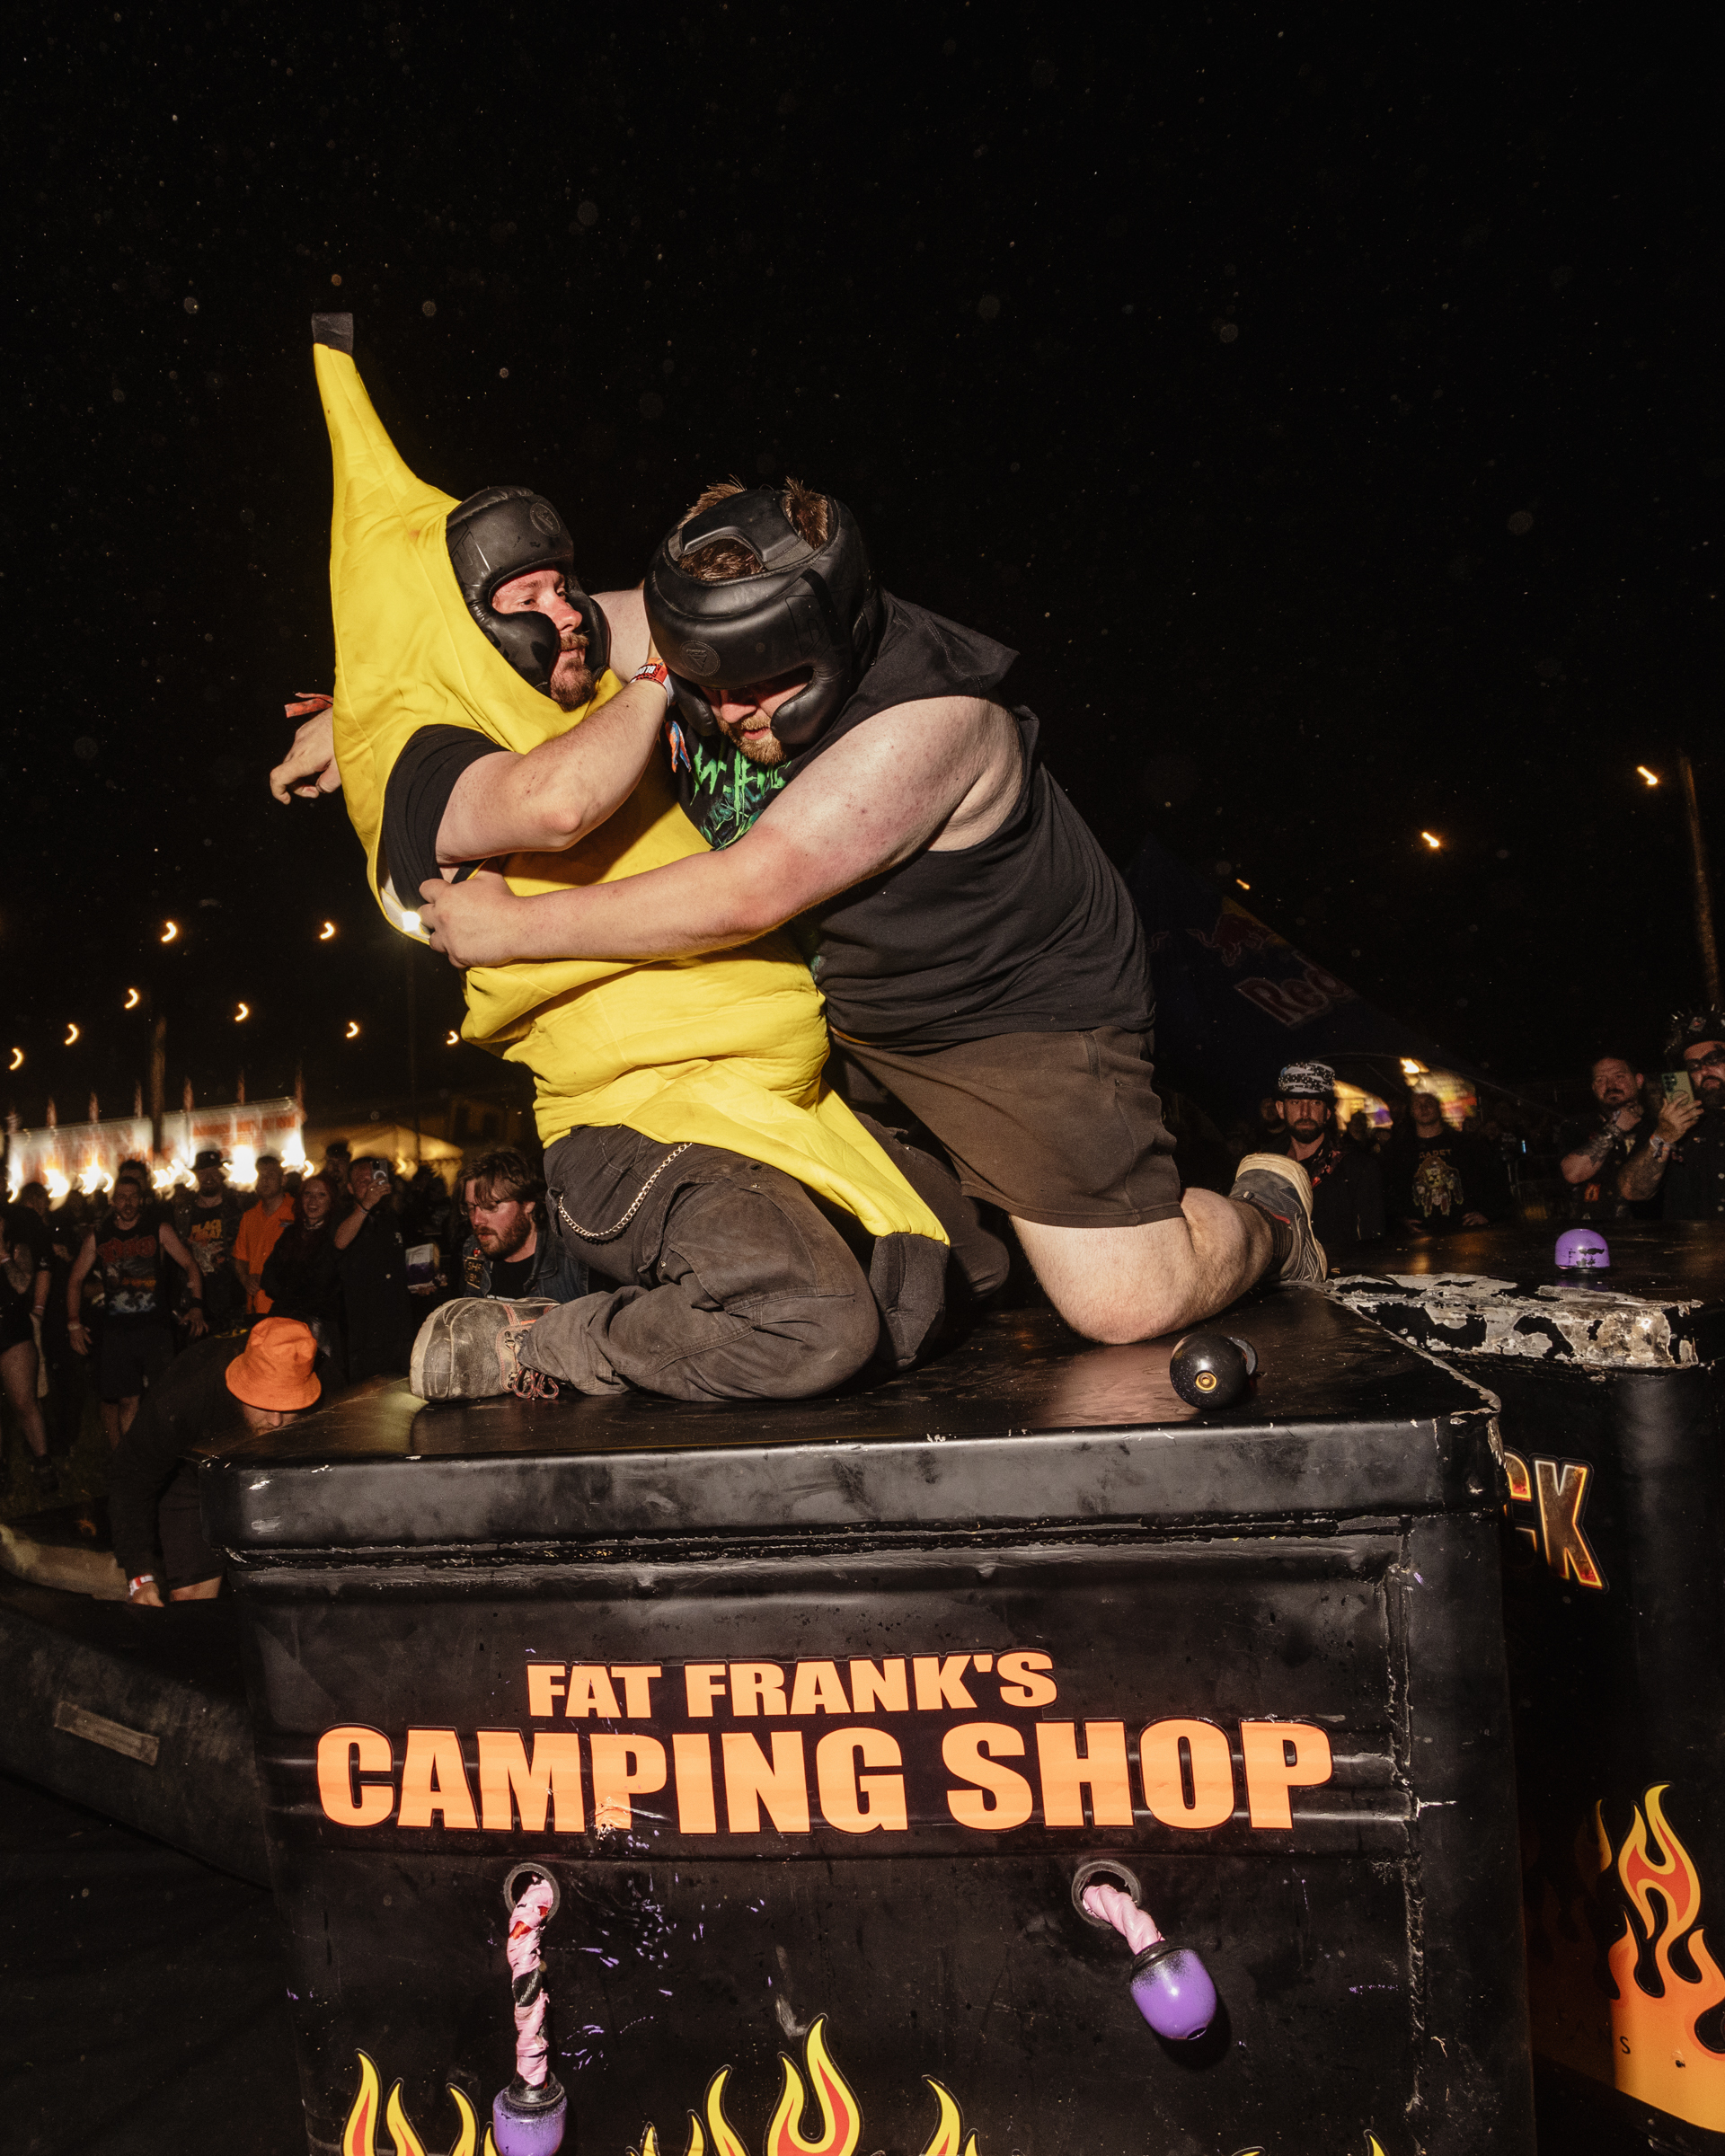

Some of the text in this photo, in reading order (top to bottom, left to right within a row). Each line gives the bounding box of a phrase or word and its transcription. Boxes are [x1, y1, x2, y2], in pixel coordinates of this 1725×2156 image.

[1233, 950, 1364, 1029] Red
[527, 1652, 1058, 1718] FAT FRANK'S
[317, 1719, 1333, 1834] CAMPING SHOP
